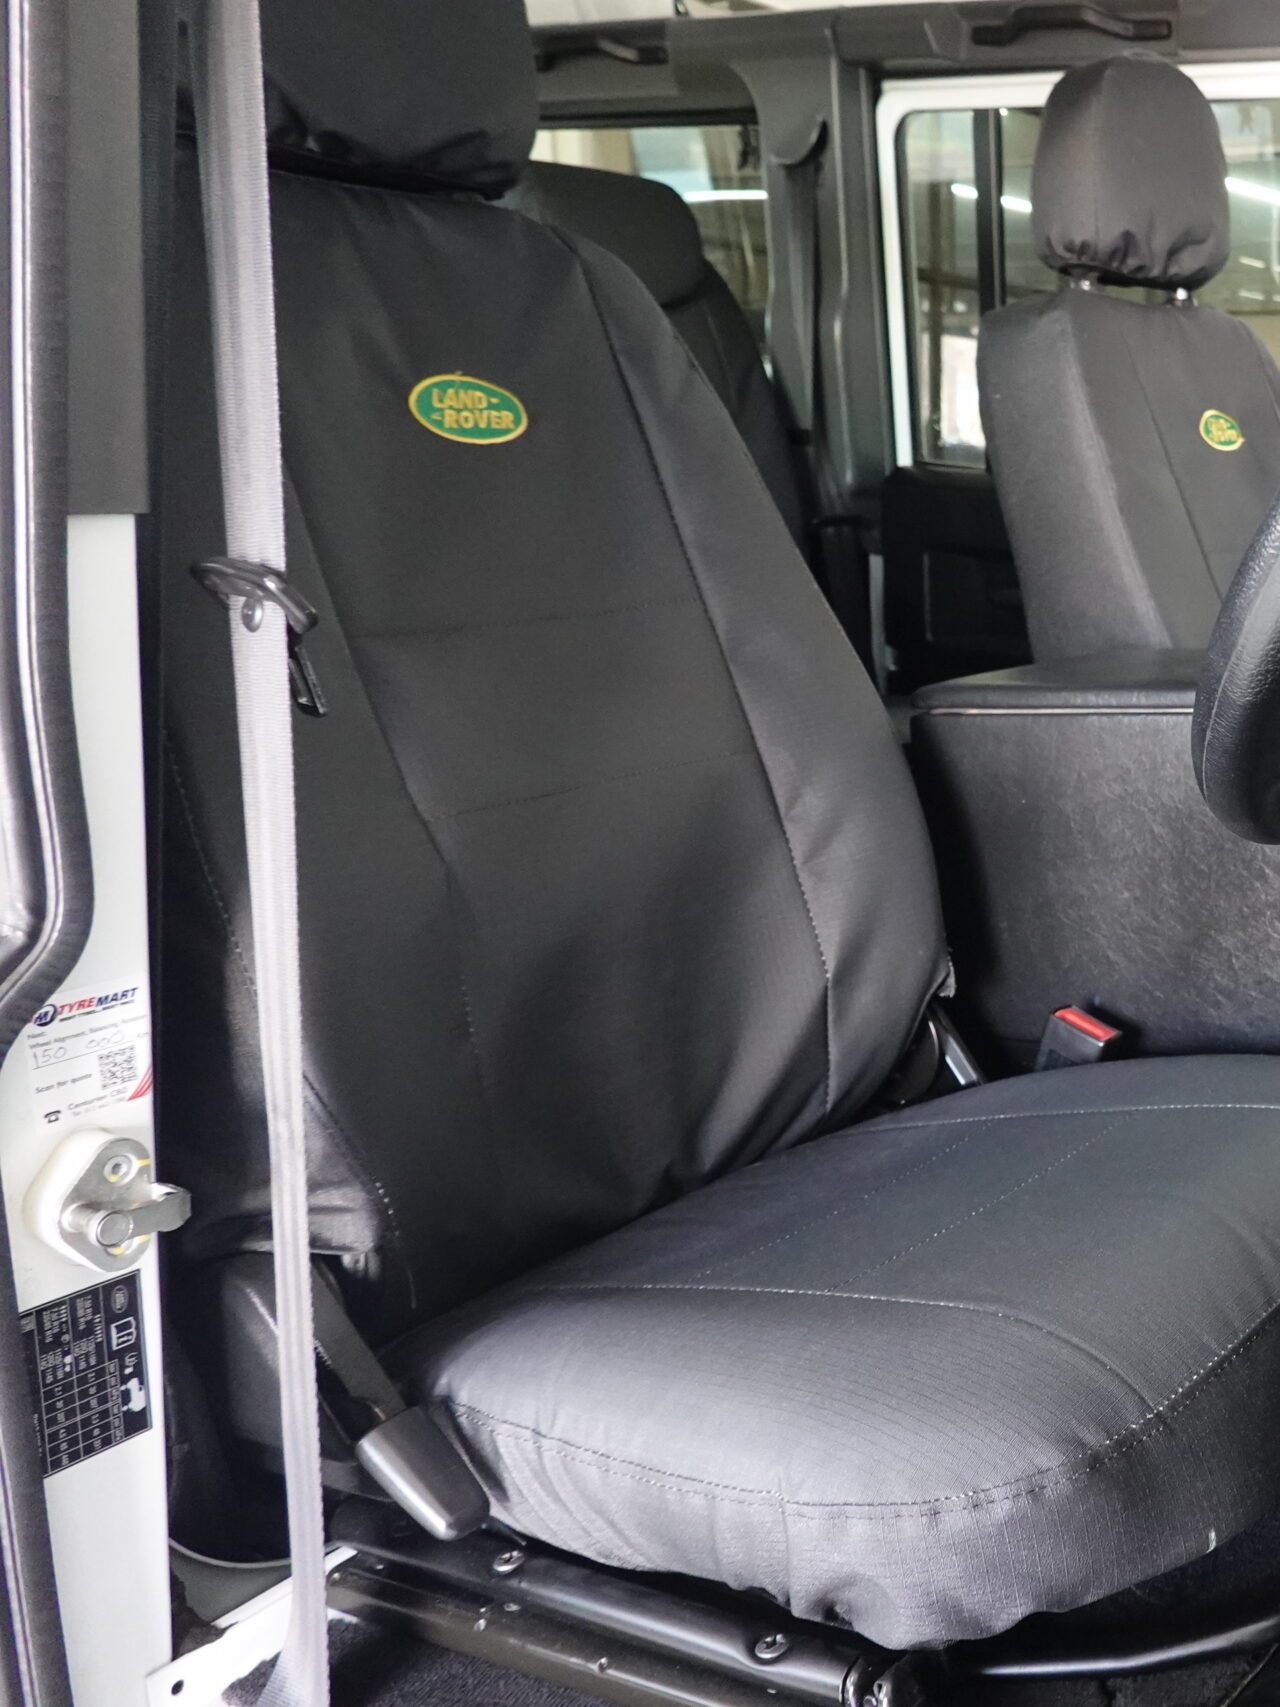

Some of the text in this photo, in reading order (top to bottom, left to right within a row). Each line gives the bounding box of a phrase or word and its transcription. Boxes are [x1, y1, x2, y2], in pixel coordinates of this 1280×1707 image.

[443, 409, 515, 429] ROVER
[58, 987, 138, 1014] TYREMART
[35, 1085, 55, 1094] Scan
